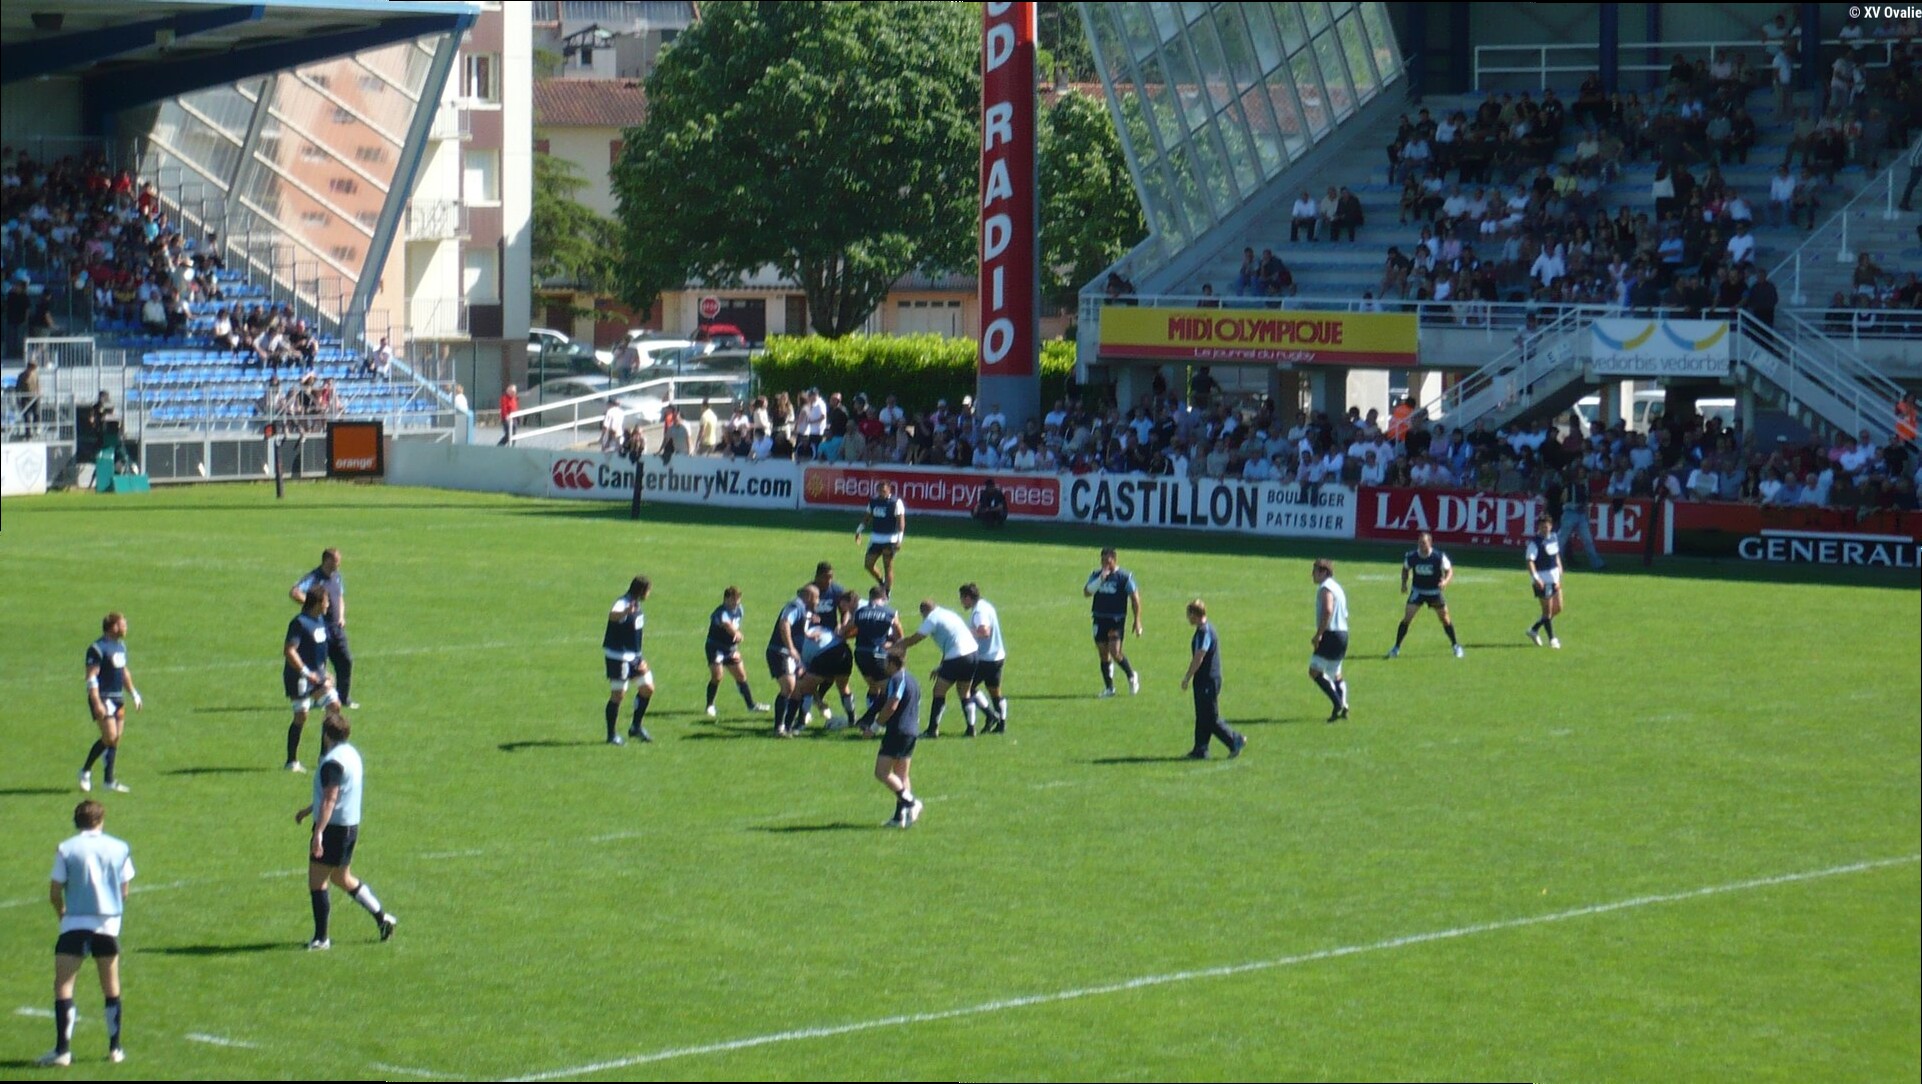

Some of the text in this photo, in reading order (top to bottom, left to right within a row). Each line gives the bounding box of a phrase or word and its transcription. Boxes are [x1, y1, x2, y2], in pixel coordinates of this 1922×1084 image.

[983, 101, 1015, 365] RADIO
[1168, 316, 1344, 345] MIDI OLYMPIQUE
[335, 458, 373, 470] orange
[598, 463, 792, 500] CanerburyNZ.com
[903, 480, 1054, 506] midi-pyrnées
[1070, 478, 1258, 529] CASTILLON
[1267, 489, 1345, 507] BOULGER
[1266, 512, 1344, 530] PATISSIER
[1375, 491, 1642, 543] LA DÉPHE
